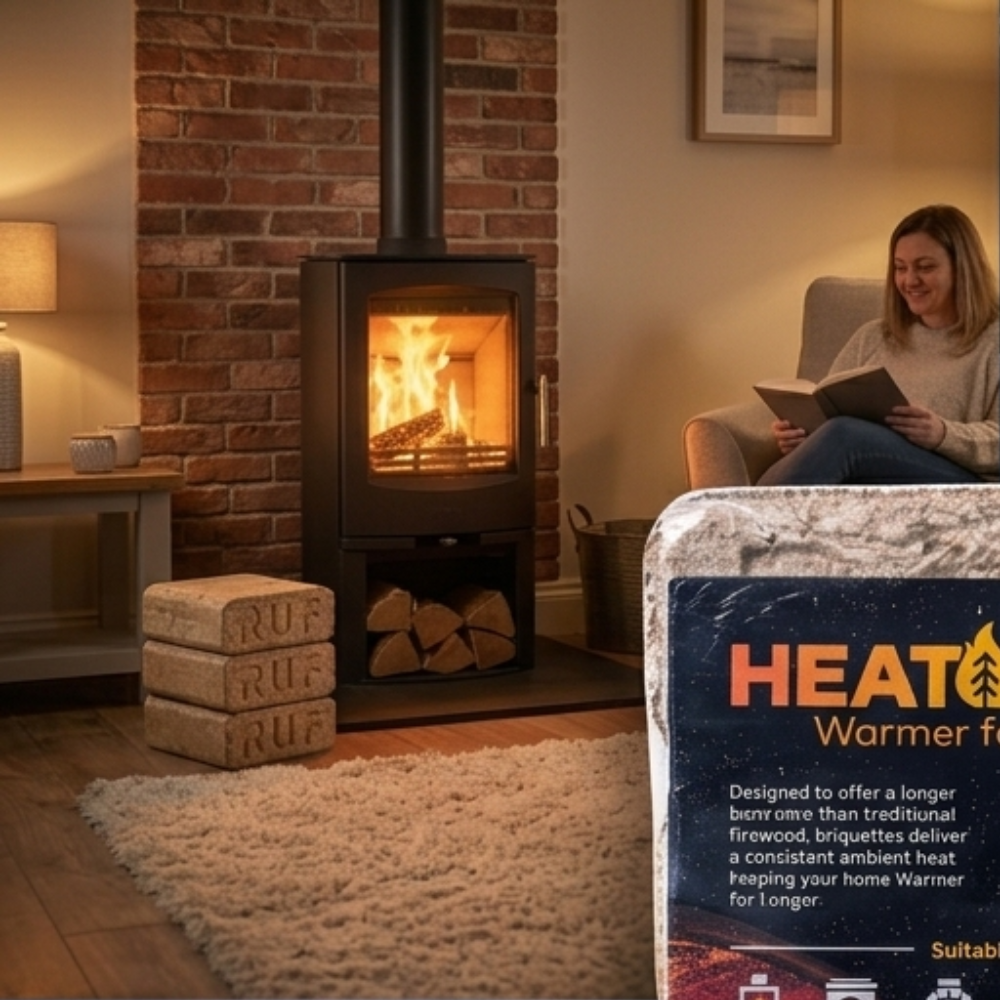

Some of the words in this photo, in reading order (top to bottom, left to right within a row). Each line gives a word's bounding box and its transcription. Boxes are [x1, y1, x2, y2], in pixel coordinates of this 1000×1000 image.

[234, 597, 321, 643] RUF
[234, 652, 322, 700] RUF
[235, 710, 323, 758] RUF
[814, 715, 970, 748] Warmer
[730, 784, 809, 803] Designed
[815, 786, 833, 800] to
[838, 785, 880, 800] offer
[885, 788, 895, 800] a
[902, 785, 956, 804] longer
[819, 806, 858, 821] than
[816, 828, 903, 846] briquettes
[909, 828, 968, 843] deliver
[730, 853, 739, 864] a
[840, 850, 910, 865] ambient
[916, 850, 956, 865] heat
[801, 874, 838, 888] your
[843, 872, 890, 886] home
[896, 873, 965, 886] Warmer
[730, 891, 754, 907] for
